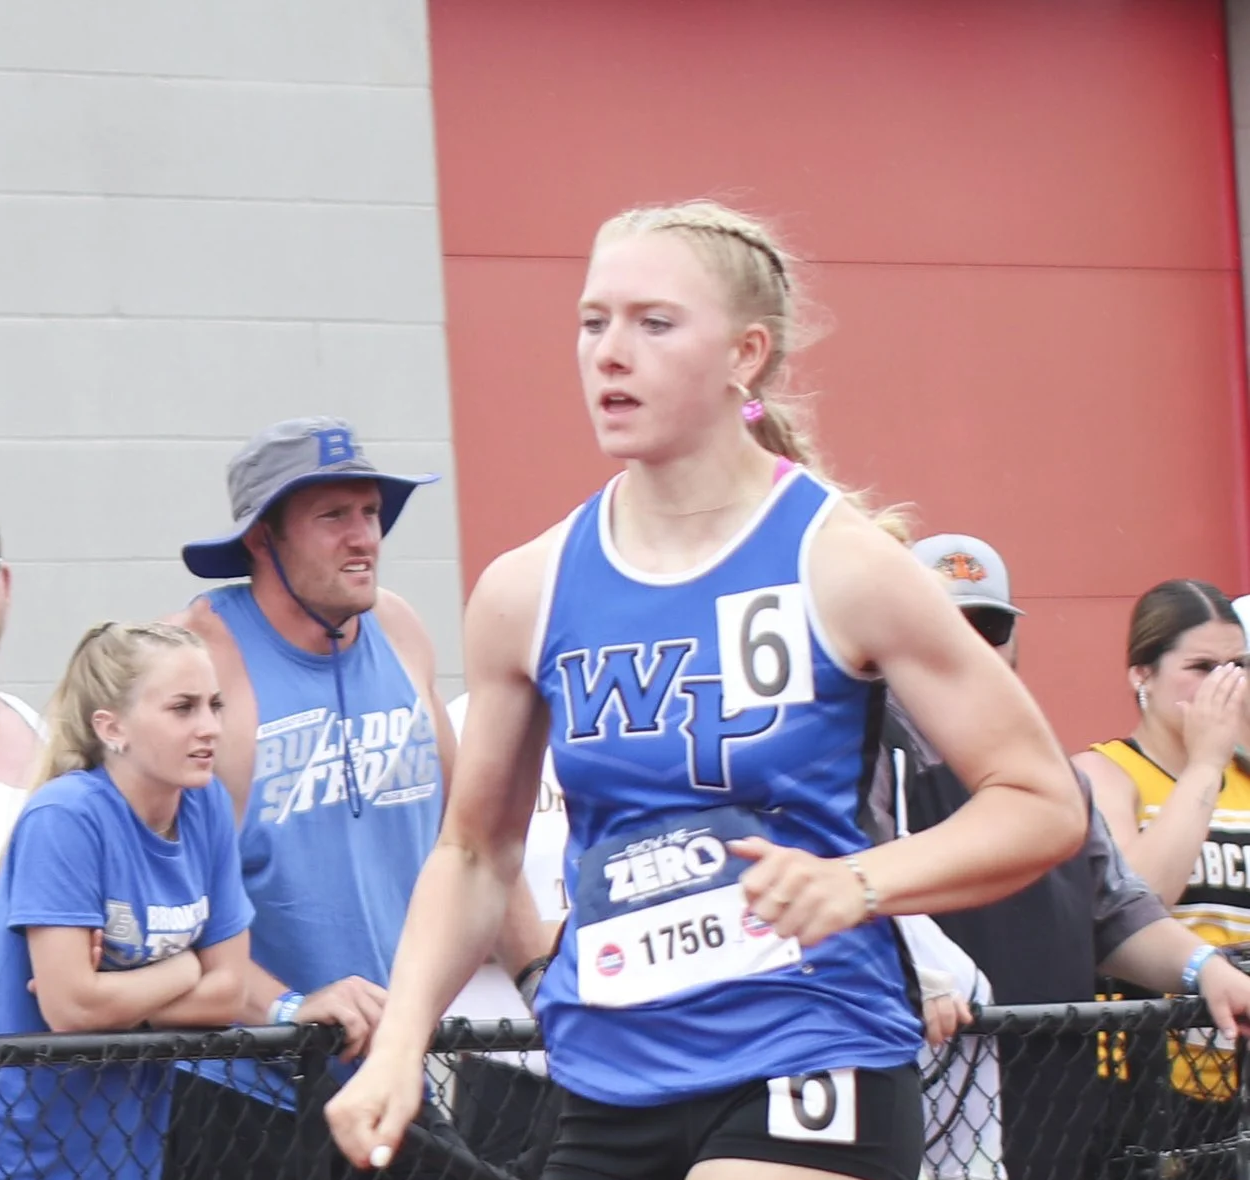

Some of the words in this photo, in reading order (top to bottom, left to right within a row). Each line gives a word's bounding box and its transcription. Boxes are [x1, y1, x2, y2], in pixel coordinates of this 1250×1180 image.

[311, 427, 356, 467] B
[740, 594, 791, 697] 6
[603, 835, 727, 903] ZERO
[639, 914, 725, 965] 1756
